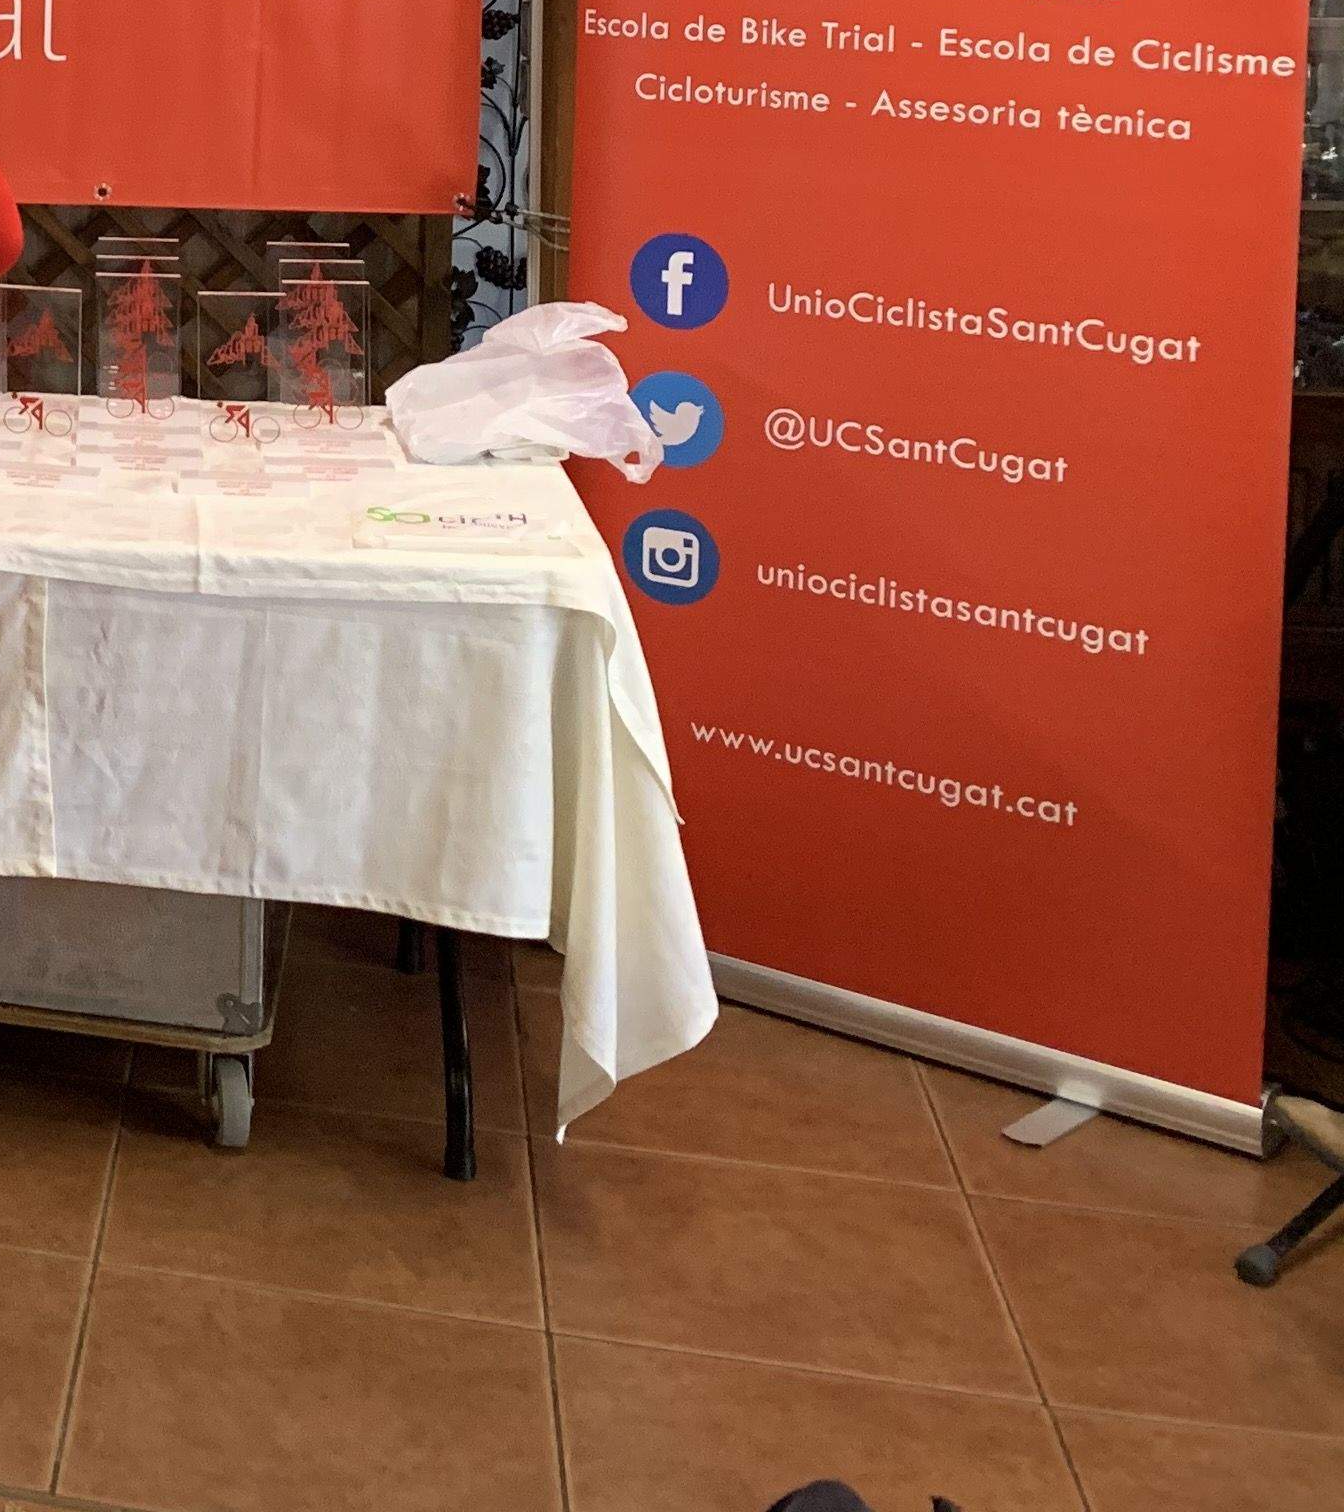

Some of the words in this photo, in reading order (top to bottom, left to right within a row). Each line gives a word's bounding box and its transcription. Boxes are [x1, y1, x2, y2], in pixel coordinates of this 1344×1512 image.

[584, 8, 669, 40] Escola
[684, 14, 726, 43] de
[741, 17, 807, 48] Bike
[821, 21, 895, 53] Trial
[939, 28, 1050, 62] Escola
[1067, 35, 1116, 67] de
[1131, 39, 1296, 77] Ciclisme
[634, 72, 830, 113] Cicloturisme
[871, 89, 1041, 129] Assesoria
[1057, 104, 1191, 141] tècnica
[768, 282, 1201, 365] UnioCiclistaSantCugat
[764, 408, 1069, 484] @UCSantCugat
[757, 563, 1150, 655] uniociclistasantcugat
[690, 721, 1078, 827] www.ucsantcugat.cat
